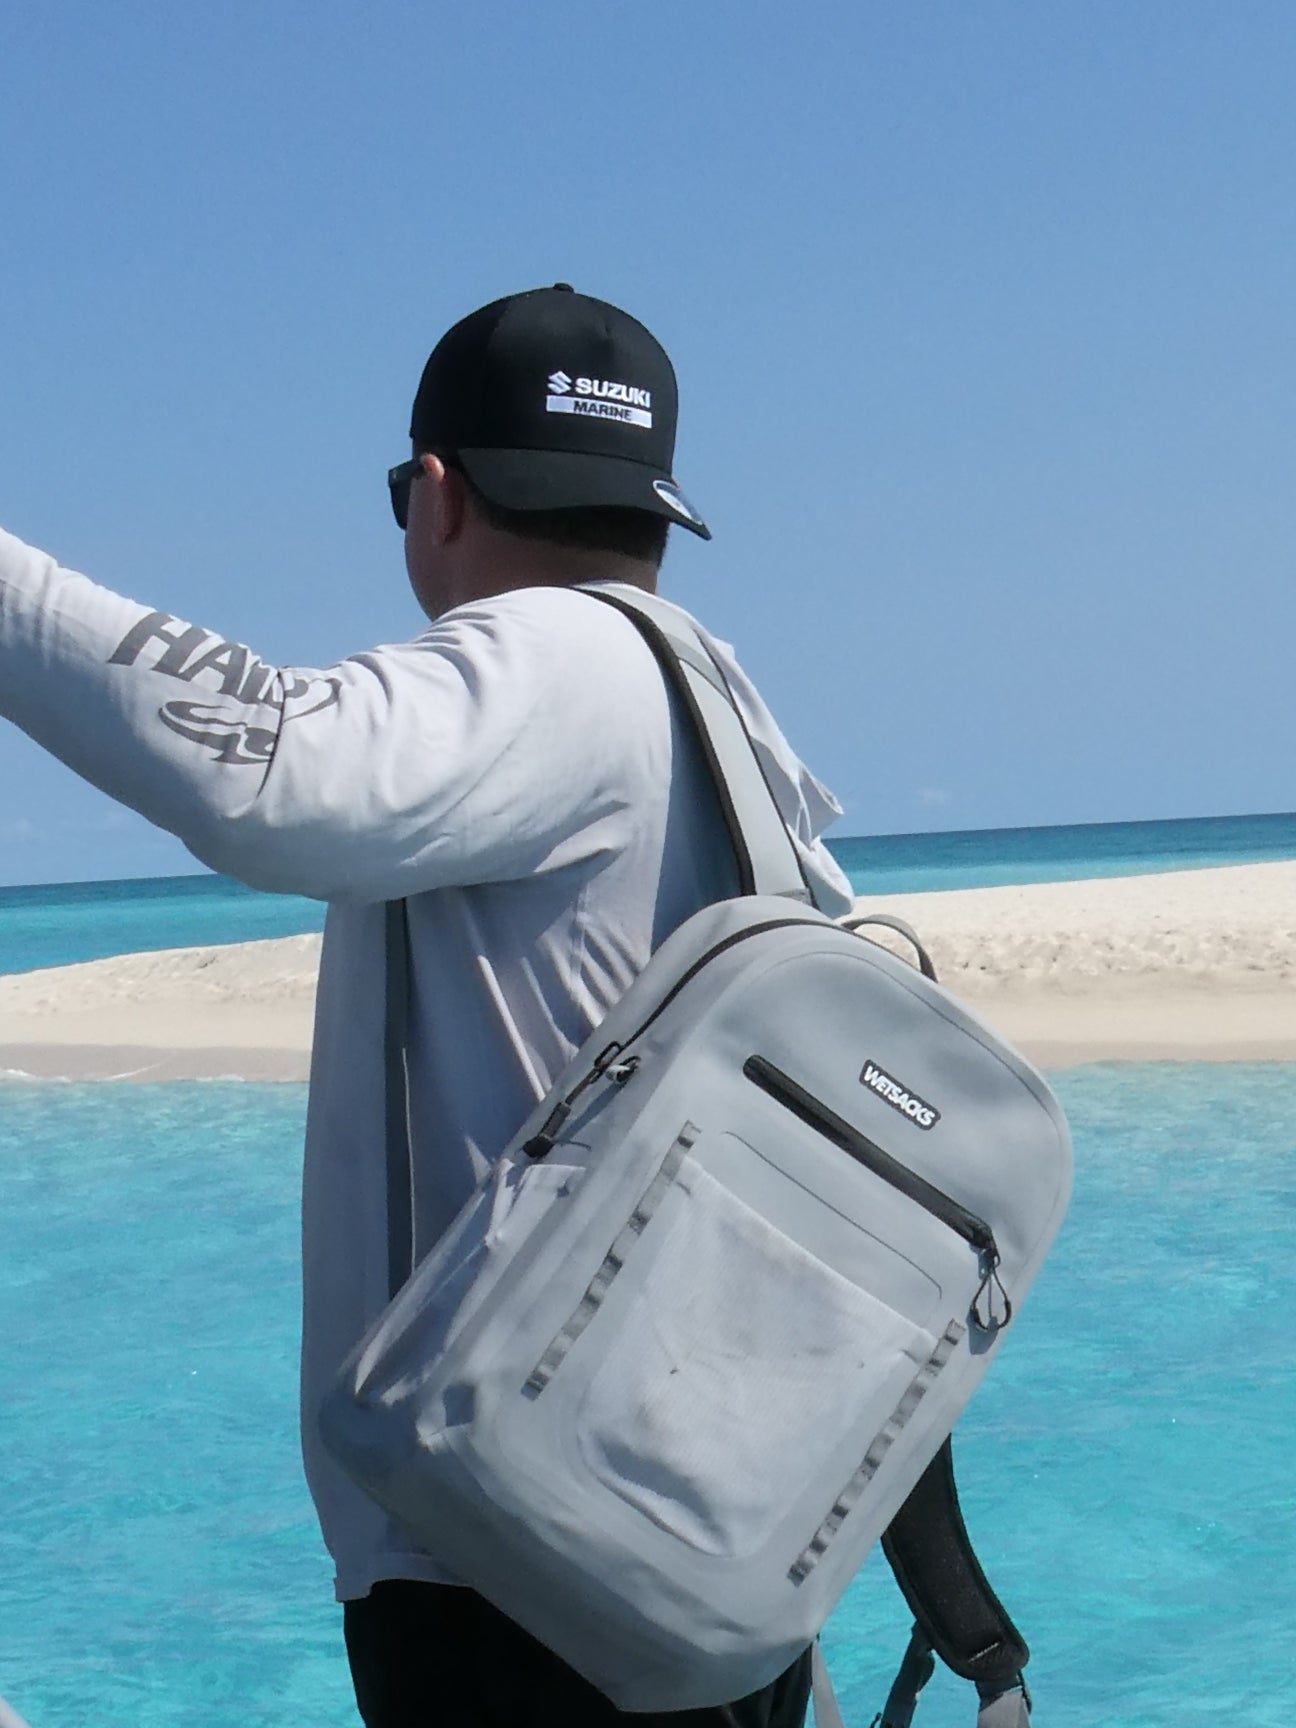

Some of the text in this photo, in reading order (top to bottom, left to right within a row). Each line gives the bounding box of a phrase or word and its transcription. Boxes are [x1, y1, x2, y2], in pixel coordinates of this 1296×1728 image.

[574, 377, 651, 408] SUZUKI
[573, 400, 633, 422] MARINE
[862, 1064, 936, 1127] WETSACKS
